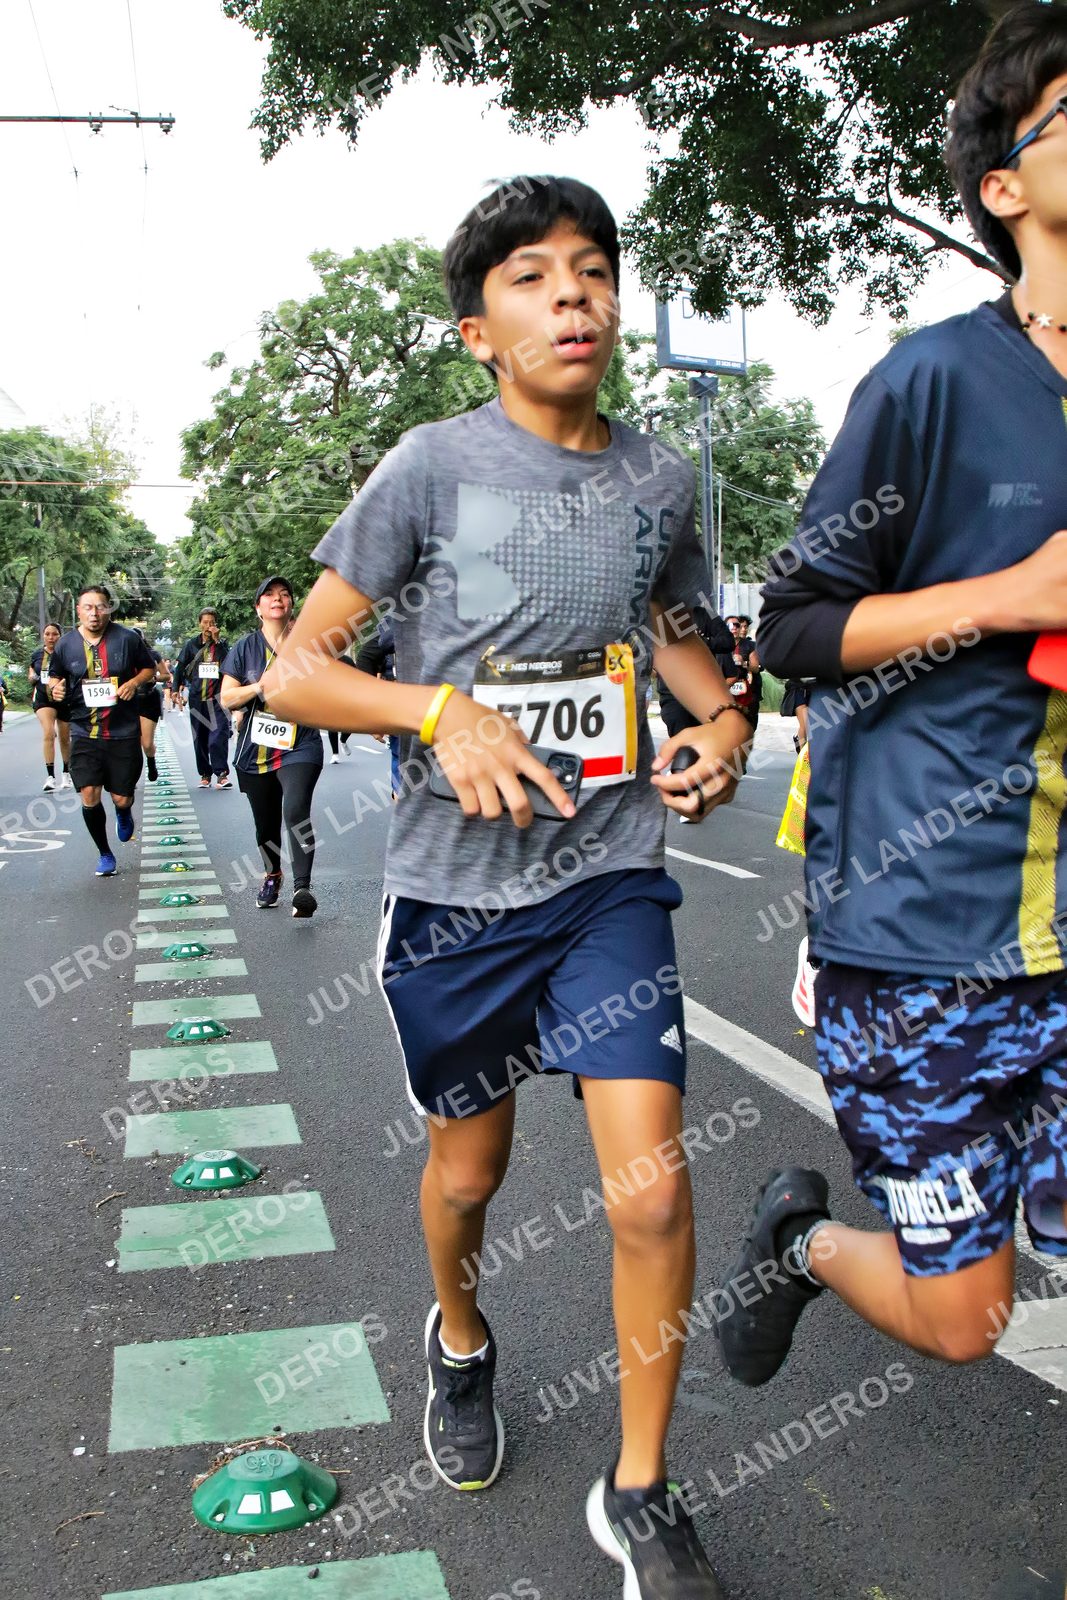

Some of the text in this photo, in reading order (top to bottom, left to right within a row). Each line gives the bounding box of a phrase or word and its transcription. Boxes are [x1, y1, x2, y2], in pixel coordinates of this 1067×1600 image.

[529, 661, 562, 671] NEGROS
[87, 687, 111, 698] 1594
[257, 722, 287, 737] 7609
